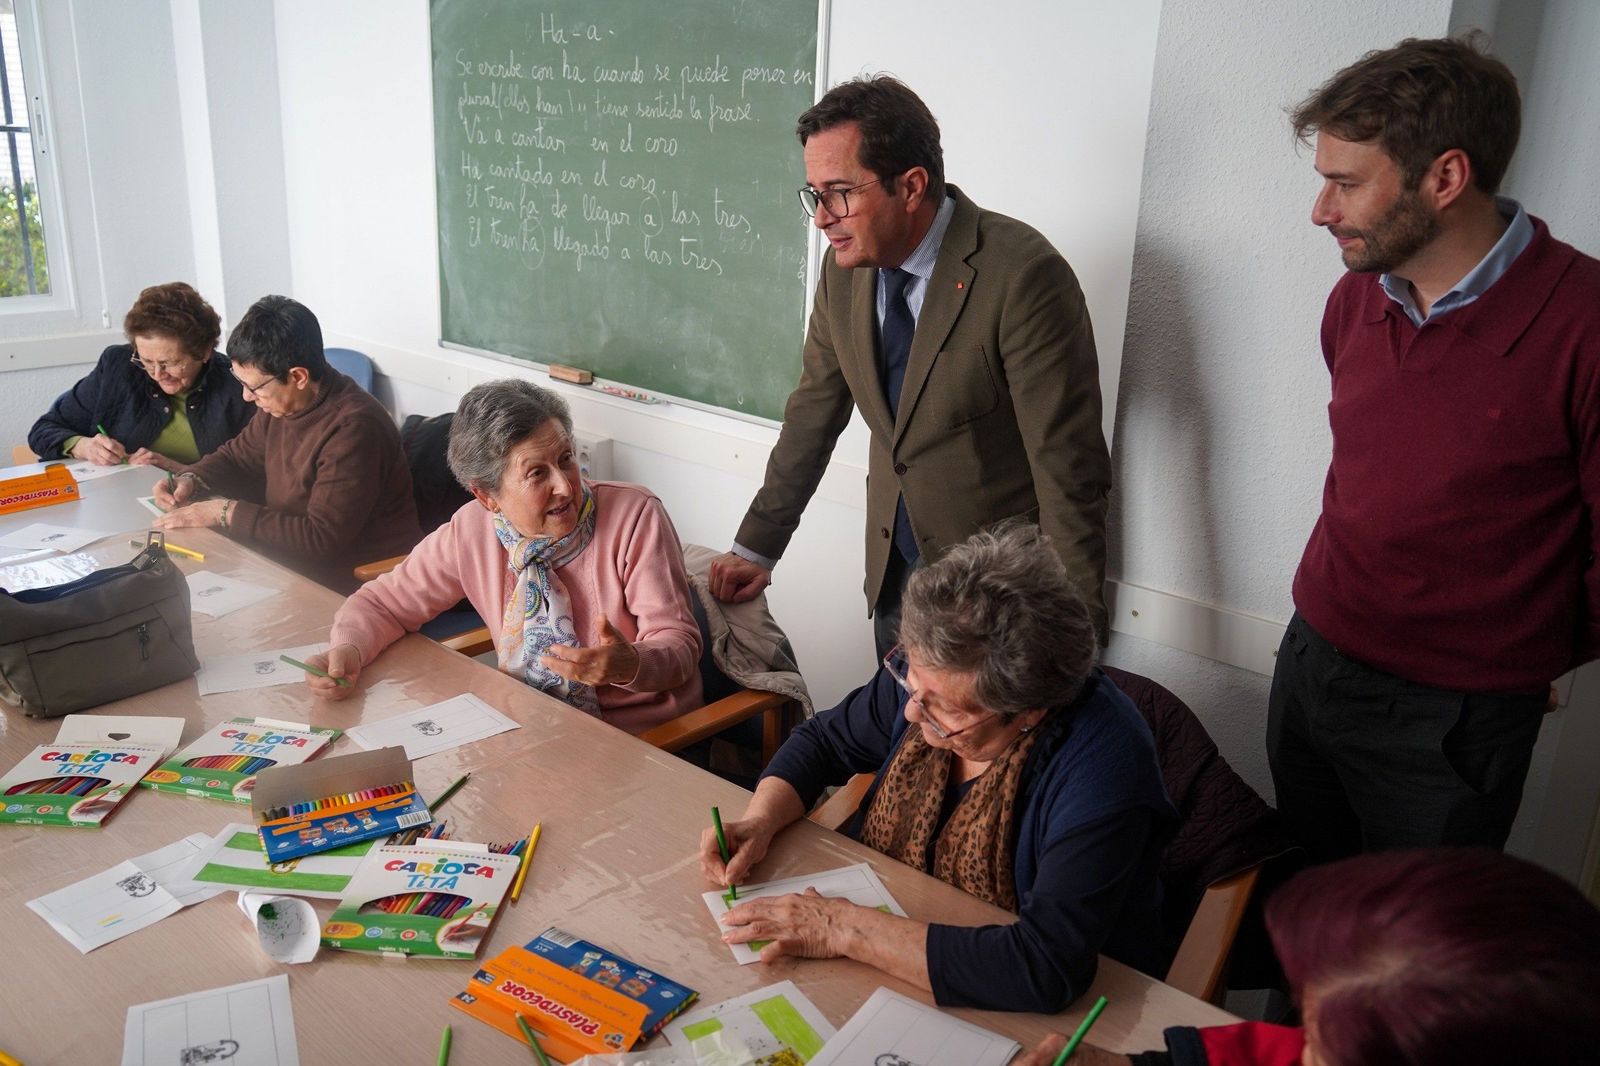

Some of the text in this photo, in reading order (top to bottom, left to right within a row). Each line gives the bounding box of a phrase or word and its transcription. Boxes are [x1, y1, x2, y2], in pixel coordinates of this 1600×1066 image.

[456, 48, 812, 100] Se escribe con ha cuando se puede poner en
[595, 88, 629, 118] tiene
[636, 90, 684, 120] sentido
[690, 95, 702, 120] la
[463, 114, 488, 145] Va
[495, 128, 504, 145] a
[590, 136, 609, 153] en
[620, 122, 633, 153] el
[645, 137, 679, 157] coro
[461, 150, 482, 180] Ha
[488, 154, 553, 185] cantado
[560, 169, 583, 184] en
[593, 159, 609, 187] el
[484, 184, 515, 211] tren
[519, 182, 540, 219] ha
[551, 188, 568, 218] de
[582, 193, 631, 243] llegar
[644, 213, 657, 227] a
[671, 190, 701, 226] las
[490, 217, 519, 249] tren
[522, 217, 540, 252] ha
[553, 225, 610, 272] llegado
[620, 247, 632, 260] a
[644, 234, 672, 265] las
[679, 235, 723, 276] tres
